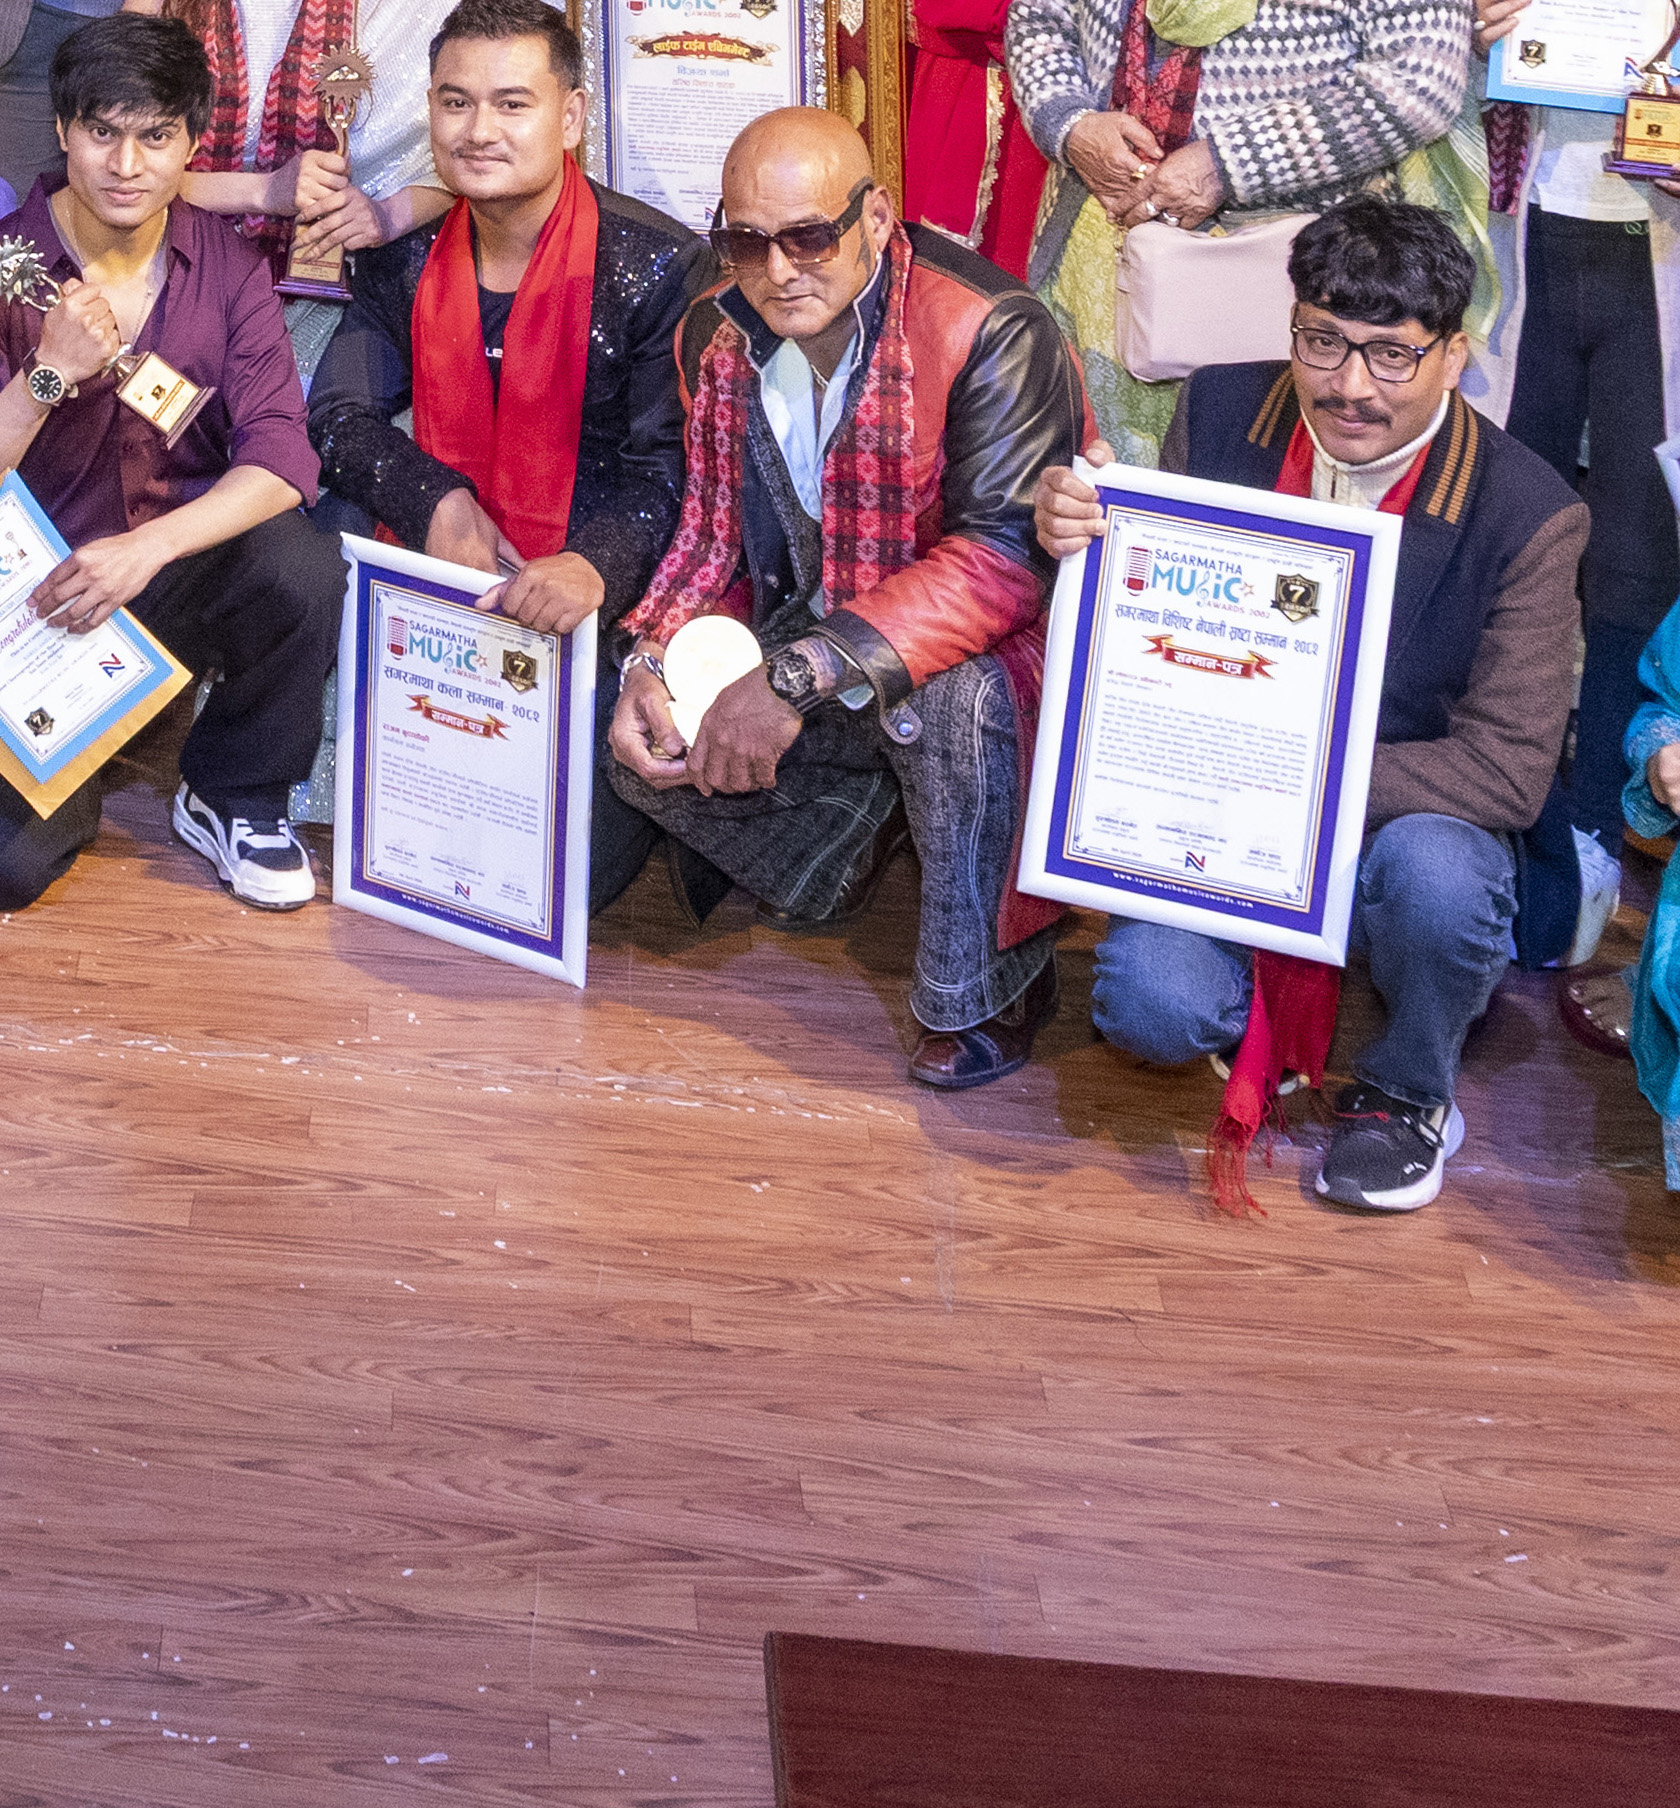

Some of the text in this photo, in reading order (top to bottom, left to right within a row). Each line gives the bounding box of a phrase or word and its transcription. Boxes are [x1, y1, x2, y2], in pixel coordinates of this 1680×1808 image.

[1154, 548, 1243, 576] SAGARMATHA
[1206, 600, 1246, 614] AWARDS
[409, 620, 478, 649] SAGARMATHA
[1196, 616, 1226, 637] नेपाली
[437, 681, 463, 699] कला
